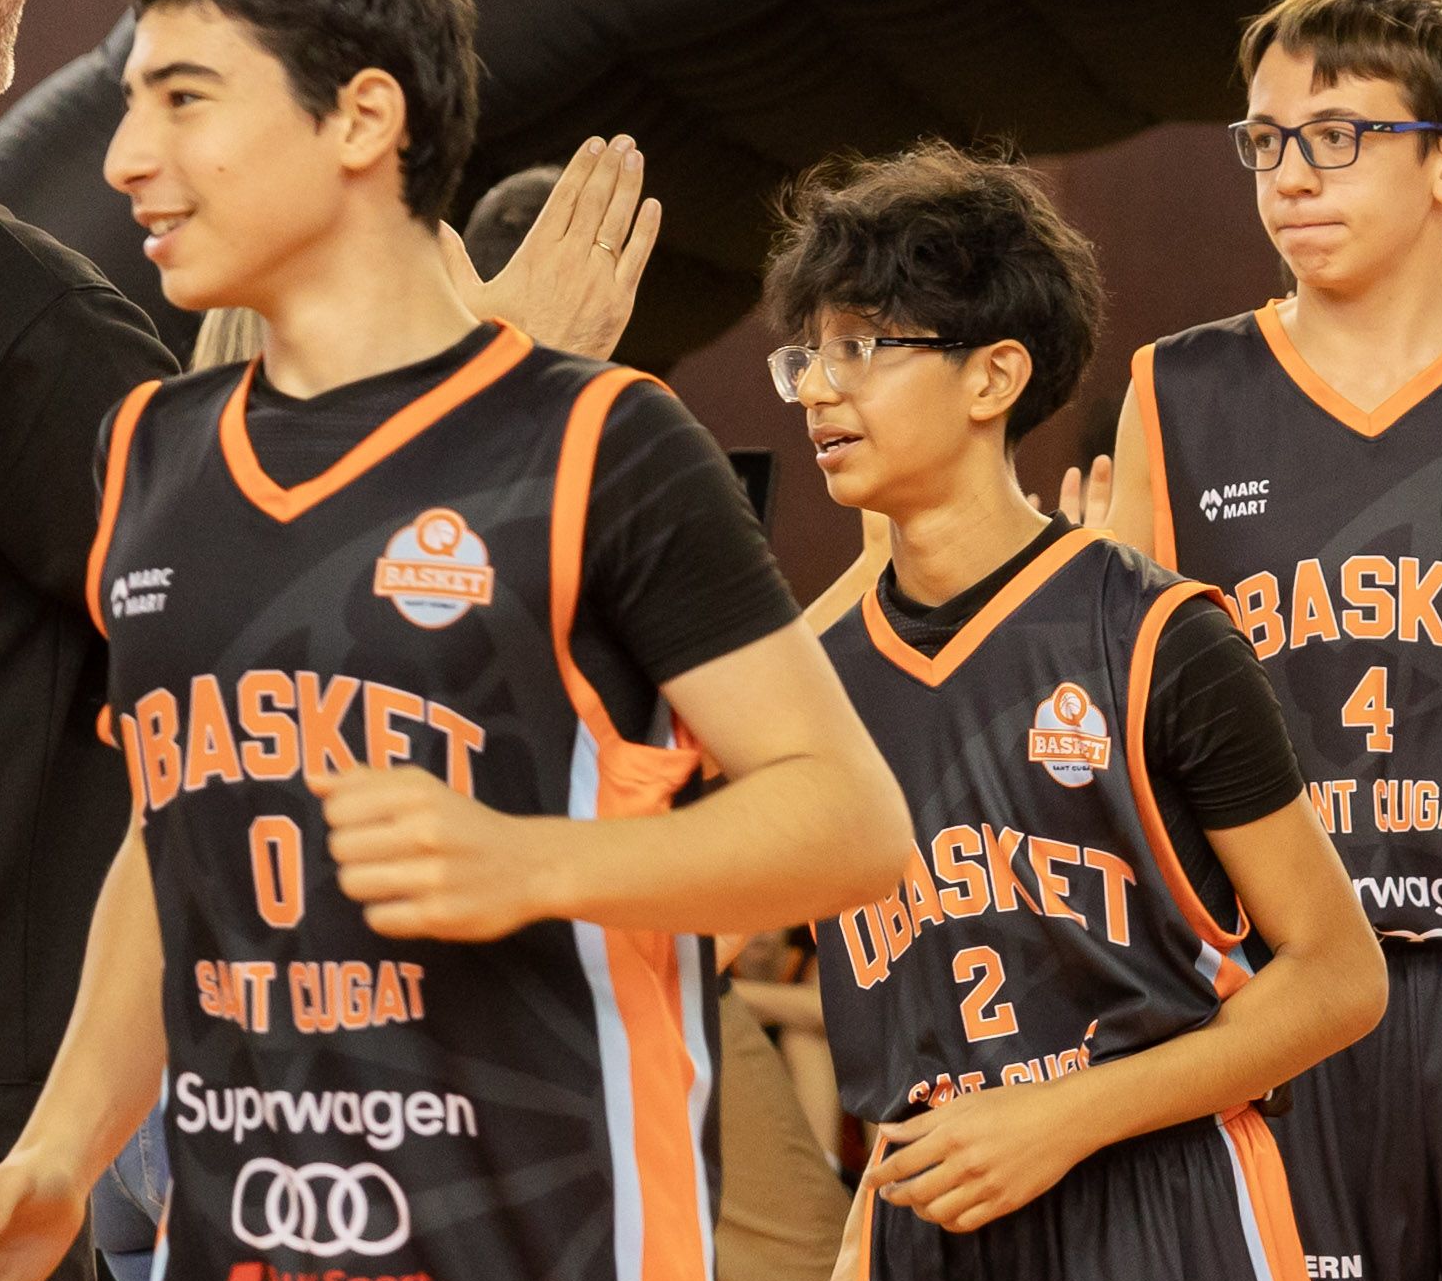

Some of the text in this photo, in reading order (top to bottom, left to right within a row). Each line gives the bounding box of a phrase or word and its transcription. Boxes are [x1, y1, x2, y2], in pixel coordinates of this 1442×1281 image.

[1222, 479, 1270, 499] MARC
[1222, 499, 1268, 520] MART
[125, 593, 168, 616] MART
[128, 567, 174, 589] MARC
[385, 565, 486, 594] BASKET
[1341, 666, 1394, 752] 4
[120, 669, 484, 826] BASKET
[1310, 779, 1357, 834] NT
[249, 814, 304, 929] 0
[839, 823, 1138, 989] QBASKET
[288, 959, 425, 1034] CUGAT
[951, 944, 1019, 1043] 2
[1303, 1254, 1363, 1279] ERN
